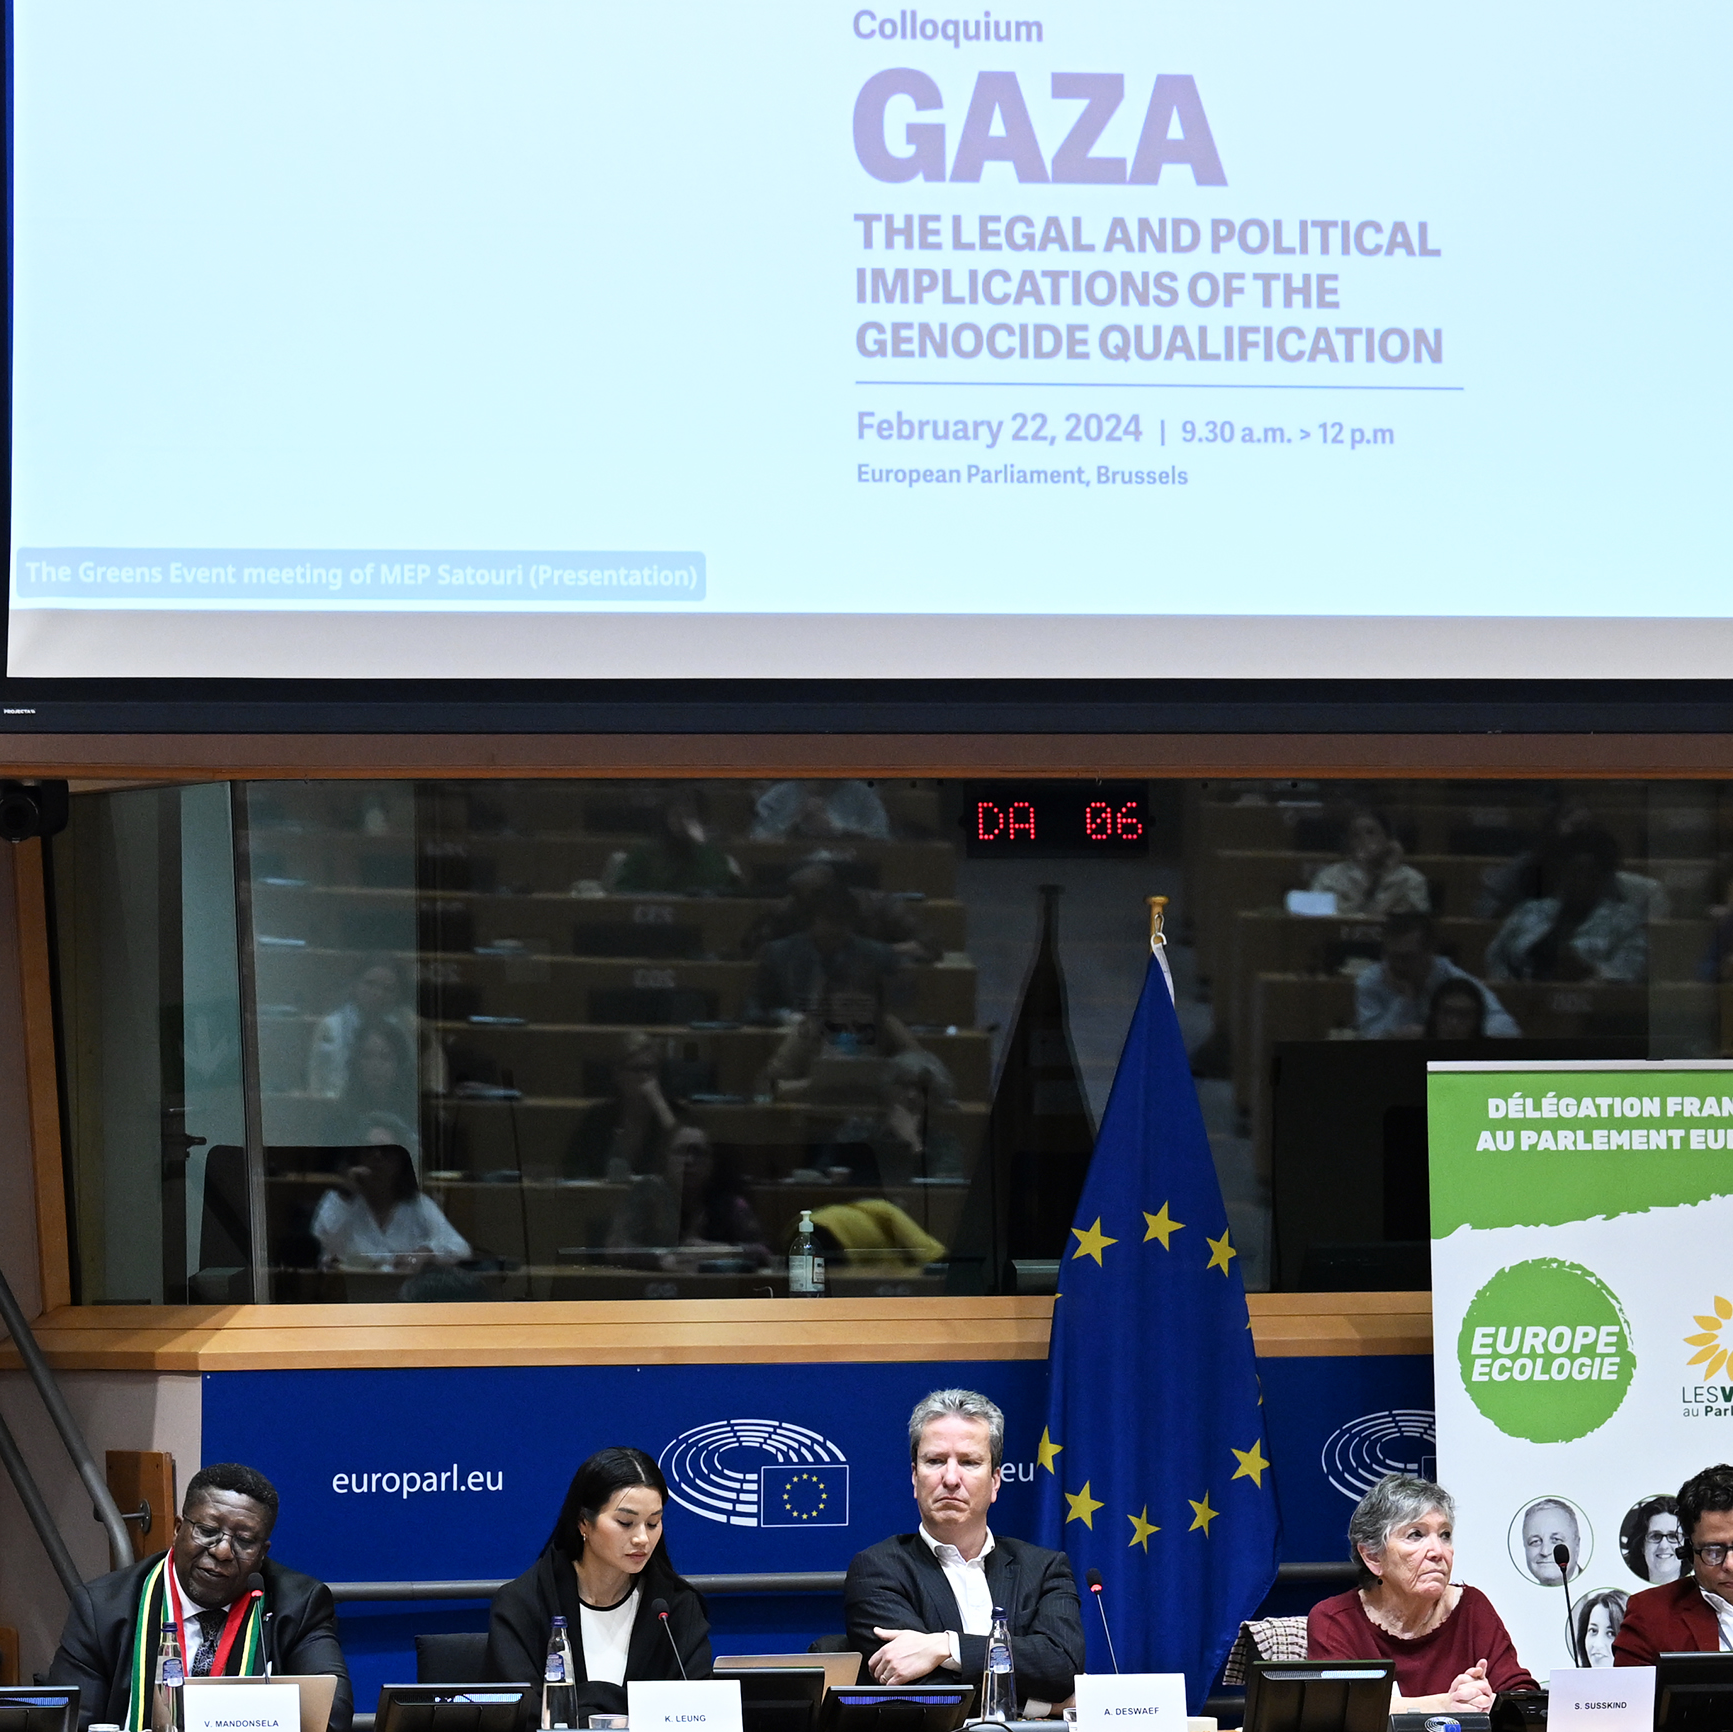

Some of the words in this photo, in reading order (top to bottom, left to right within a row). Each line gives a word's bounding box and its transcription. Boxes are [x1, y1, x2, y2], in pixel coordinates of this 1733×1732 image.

[852, 9, 1044, 48] Colloquium
[852, 66, 1229, 187] GAZA
[854, 213, 942, 251] THE
[951, 214, 1095, 253] LEGAL
[1103, 217, 1201, 254] AND
[1210, 218, 1441, 257] POLITICAL
[855, 267, 1179, 307] IMPLICATIONS
[1187, 271, 1246, 307] OF
[1253, 272, 1340, 309] THE
[855, 321, 1090, 360] GENOCIDE
[1098, 324, 1444, 365] QUALIFICATION
[857, 410, 1003, 449] February
[1010, 412, 1056, 446] 22,
[1064, 412, 1143, 443] 2024
[1181, 420, 1235, 445] 9.30
[1240, 425, 1292, 445] a.m.
[1318, 421, 1345, 445] 12
[1350, 426, 1395, 450] p.m
[856, 463, 962, 489] European
[966, 463, 1092, 488] Parliament,
[1096, 464, 1189, 486] Brussels
[25, 560, 72, 584] The
[78, 561, 162, 584] Greens
[169, 562, 237, 585] Event
[243, 561, 343, 591] meeting
[349, 562, 375, 587] of
[380, 564, 431, 587] MEP
[437, 564, 524, 588] Satouri
[529, 565, 699, 591] (Presentation)
[978, 801, 1036, 840] DA
[1085, 801, 1143, 840] 06
[1488, 1092, 1661, 1119] DÉLÉGATION
[1475, 1130, 1514, 1152] AU
[1520, 1128, 1685, 1151] PARLEMENT
[1470, 1325, 1620, 1355] EUROPE
[1471, 1357, 1621, 1382] ECOLOGIE
[1682, 1407, 1699, 1418] au
[332, 1463, 504, 1499] europarl.eu
[676, 1714, 706, 1722] LEUNG
[1104, 1708, 1113, 1716] A.
[1115, 1707, 1159, 1715] DESWAEF
[1574, 1702, 1583, 1710] S.
[1584, 1701, 1627, 1710] SUSSKIND
[204, 1720, 213, 1728] V.
[215, 1719, 279, 1728] MANDONSELA
